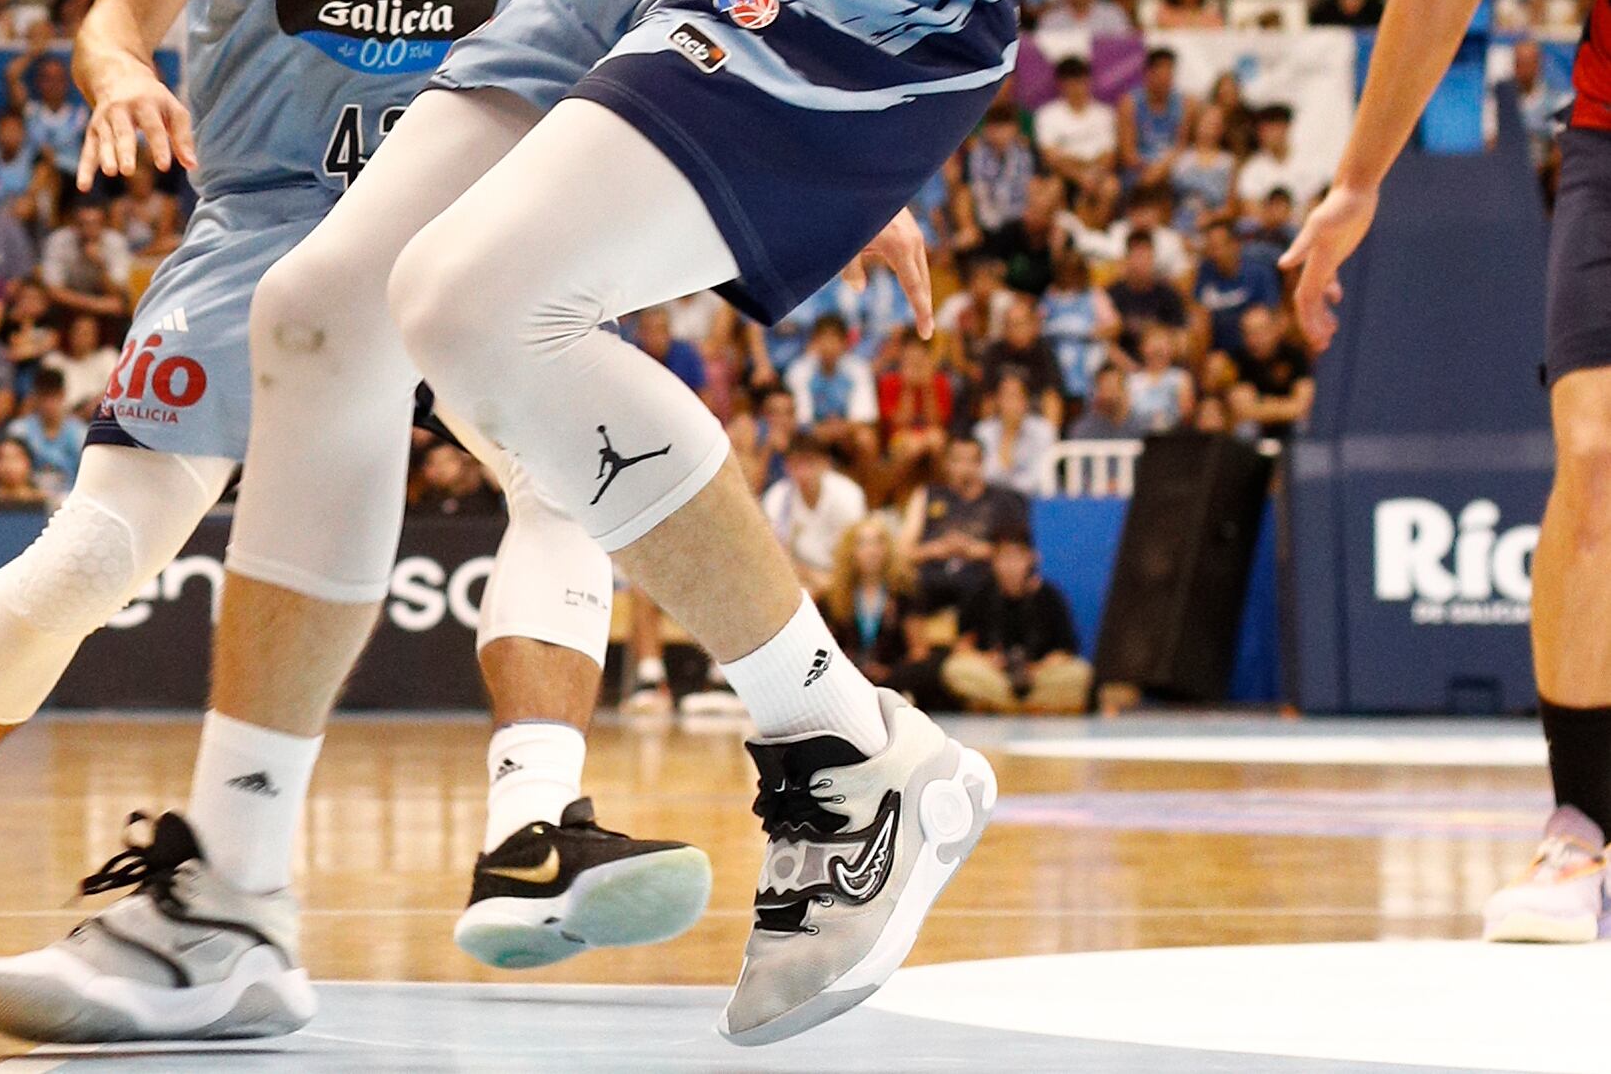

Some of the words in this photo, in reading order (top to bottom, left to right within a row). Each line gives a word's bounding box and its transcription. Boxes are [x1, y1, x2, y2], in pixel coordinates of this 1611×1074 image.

[672, 31, 710, 61] acb
[322, 104, 409, 192] 4
[116, 404, 179, 424] GALICIA
